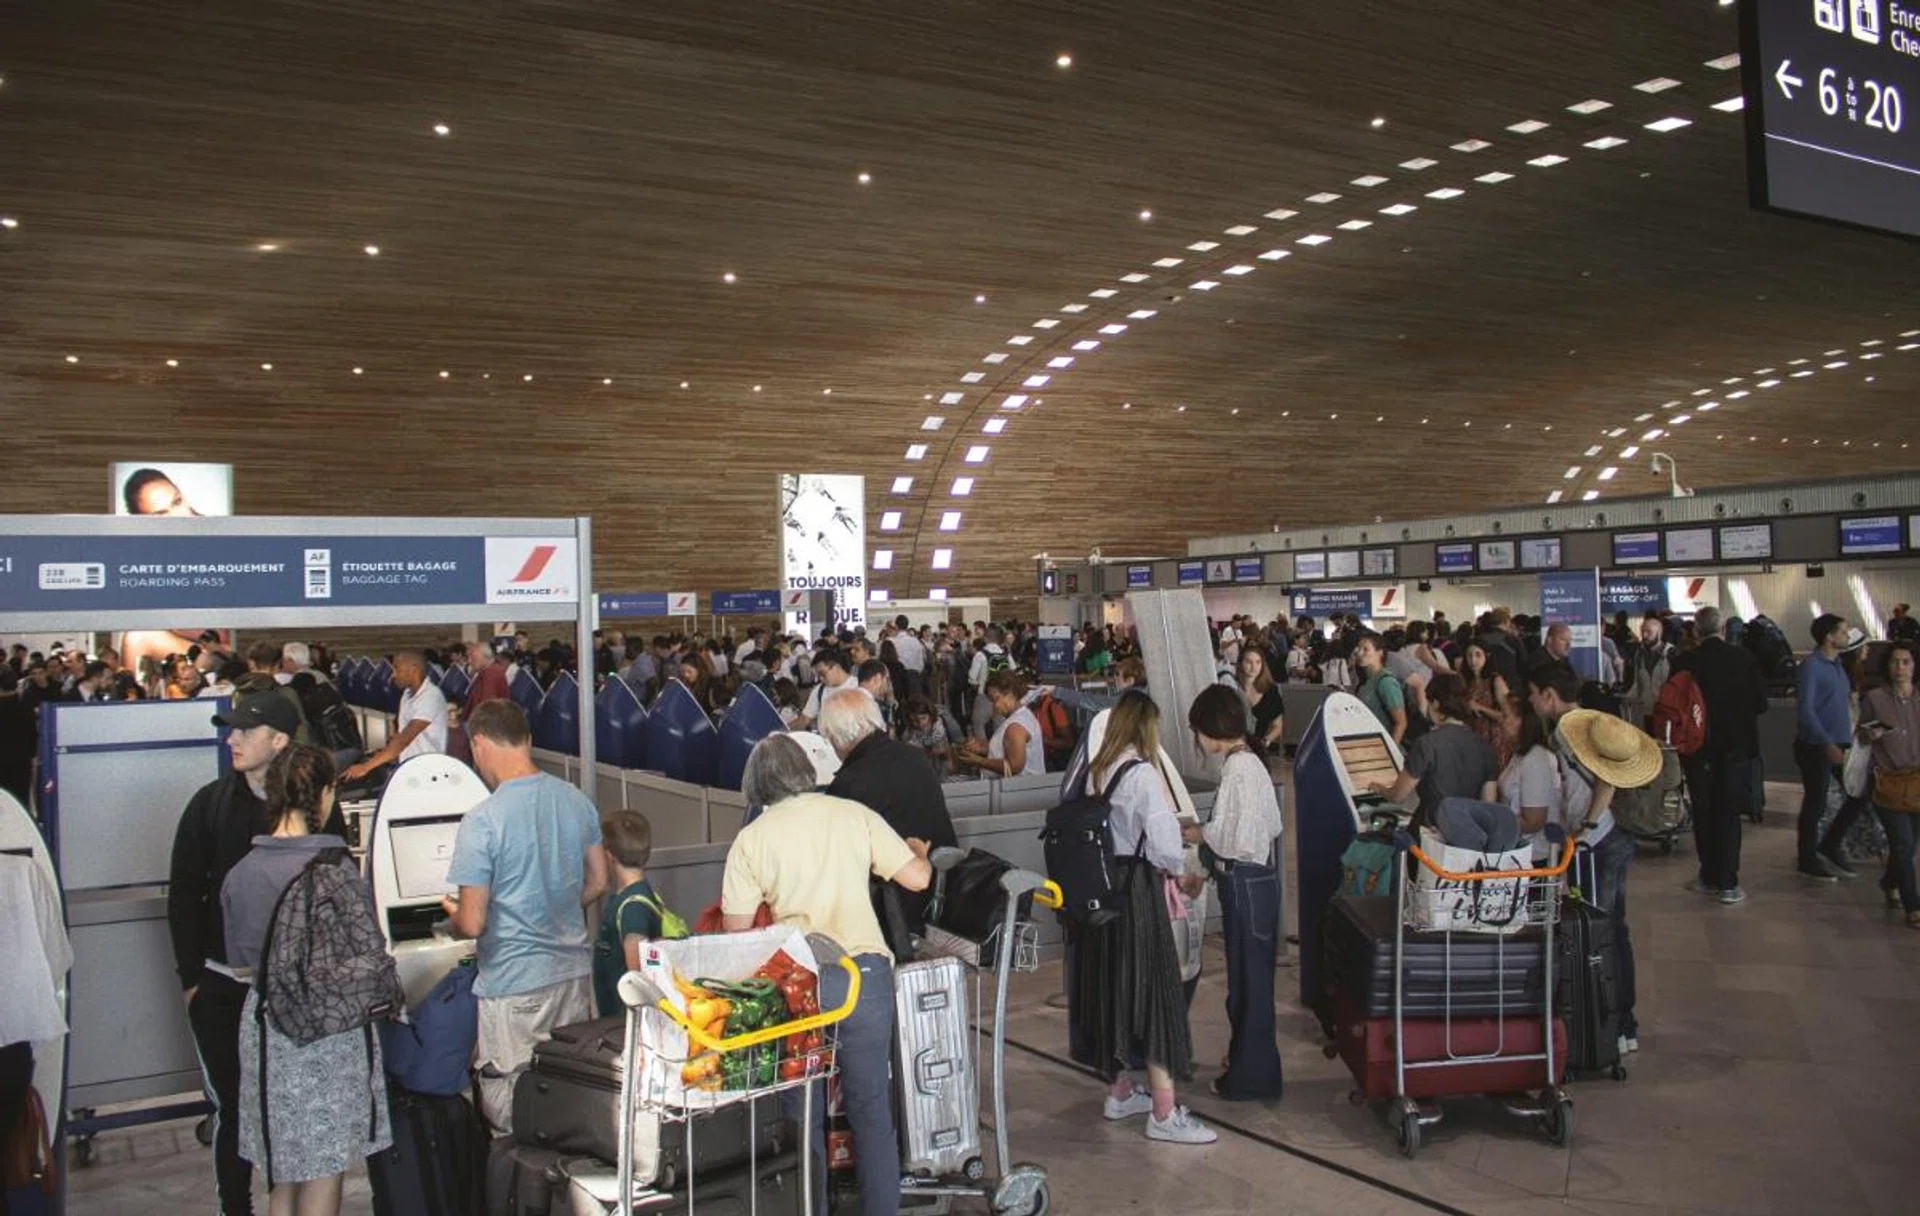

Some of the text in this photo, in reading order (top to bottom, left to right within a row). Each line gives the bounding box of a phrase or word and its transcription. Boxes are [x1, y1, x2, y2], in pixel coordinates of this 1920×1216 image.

[1819, 68, 1839, 115] 6
[1864, 80, 1902, 133] 20
[119, 563, 286, 574] CARTE D'EMBARQUEMENT
[408, 562, 457, 571] BAGAGE
[119, 577, 226, 588] BOARDING PASS
[342, 574, 428, 585] BAGGAGE TAG
[789, 576, 862, 589] TOUJOURS
